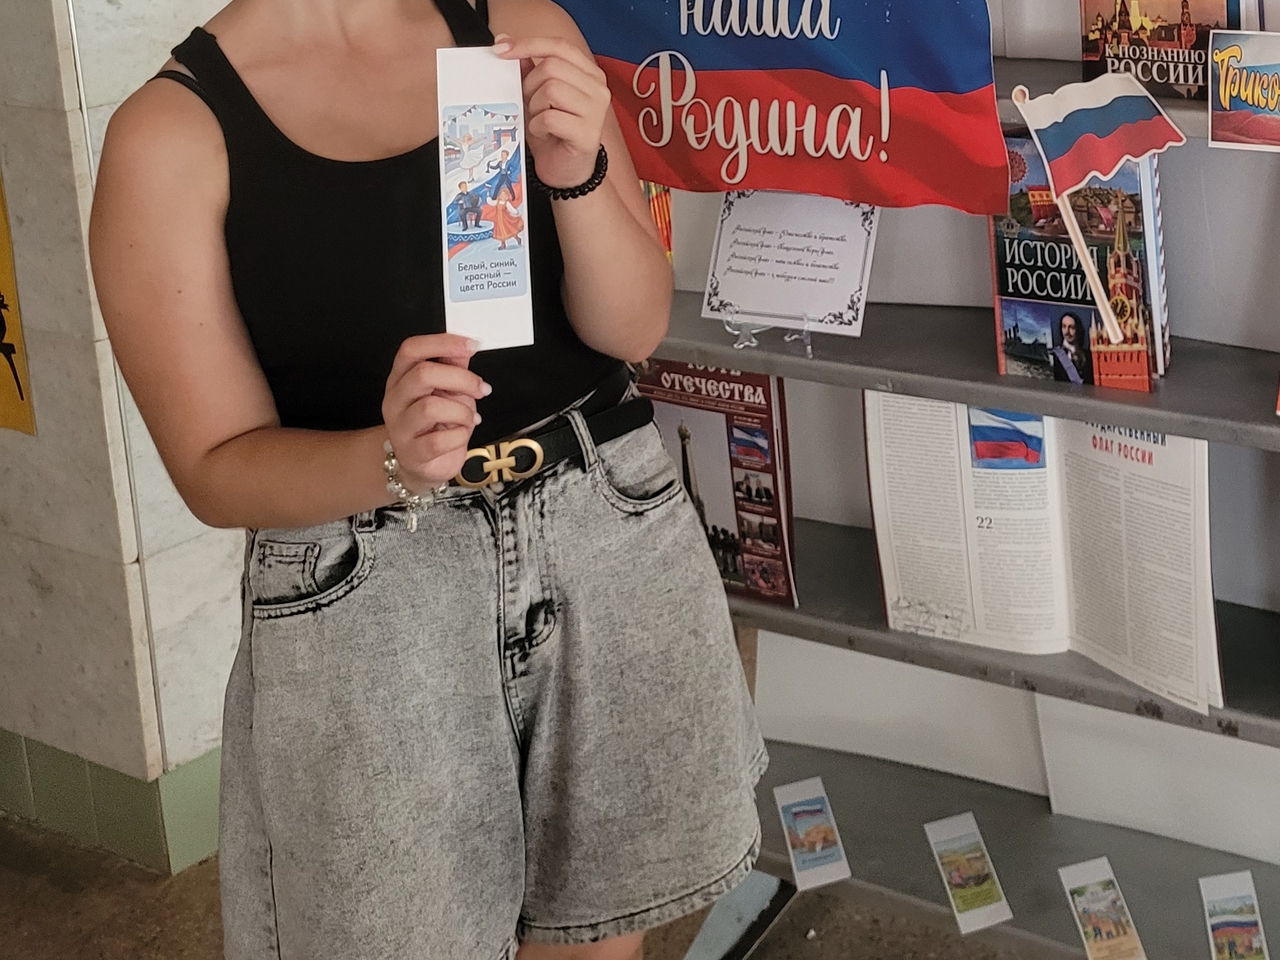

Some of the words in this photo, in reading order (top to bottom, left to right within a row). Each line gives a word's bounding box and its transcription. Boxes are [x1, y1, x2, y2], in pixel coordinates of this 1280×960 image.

[1105, 44, 1114, 57] К
[1119, 44, 1206, 64] ПОЗНАНИЮ
[1106, 57, 1205, 86] РОССИИ
[632, 50, 890, 185] Родина!
[457, 262, 488, 273] Белый,
[489, 258, 517, 270] синий,
[459, 282, 484, 292] цвета
[487, 279, 517, 289] России
[464, 270, 501, 282] красный
[1006, 267, 1093, 301] РОССИИ
[661, 371, 767, 405] ОТЕЧЕСТВА
[975, 516, 993, 530] 22
